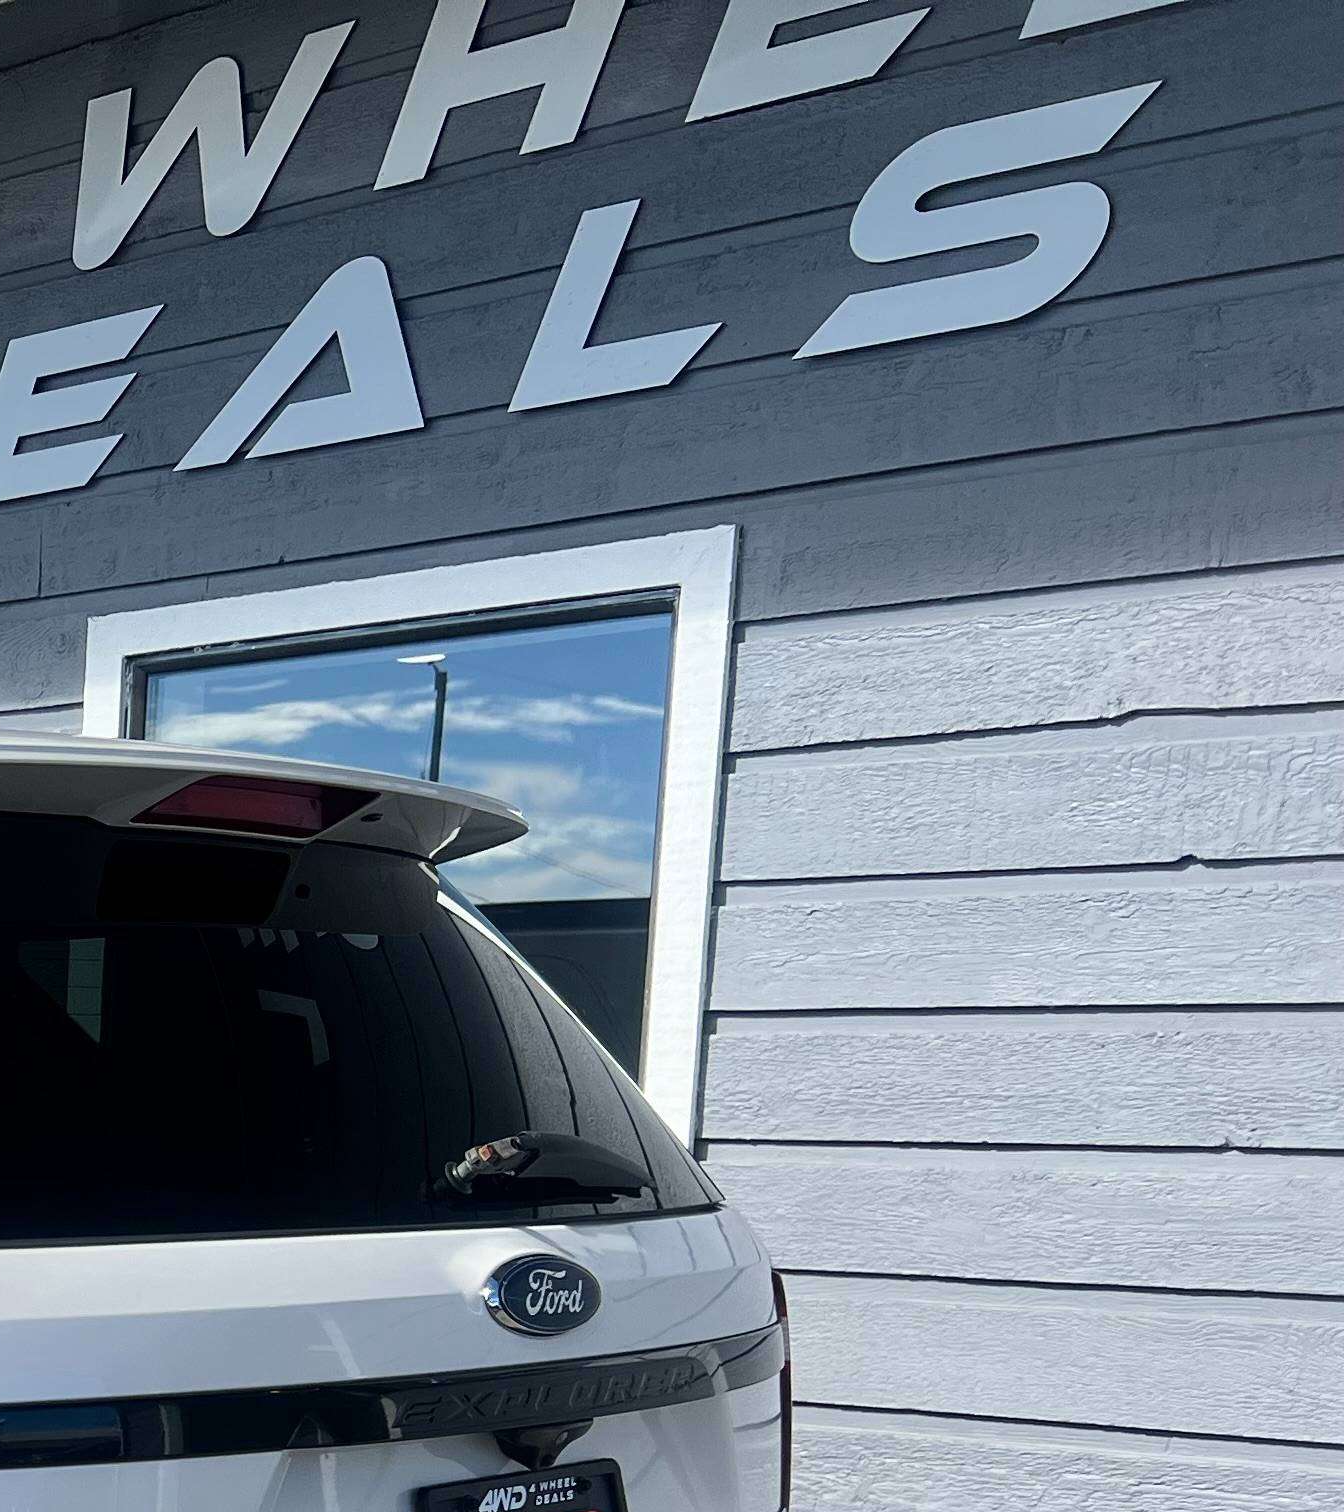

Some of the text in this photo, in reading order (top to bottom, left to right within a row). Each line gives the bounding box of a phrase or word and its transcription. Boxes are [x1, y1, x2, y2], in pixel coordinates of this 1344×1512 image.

[525, 1268, 584, 1316] Ford
[539, 1476, 577, 1492] WHEEL
[535, 1489, 574, 1506] DEALS
